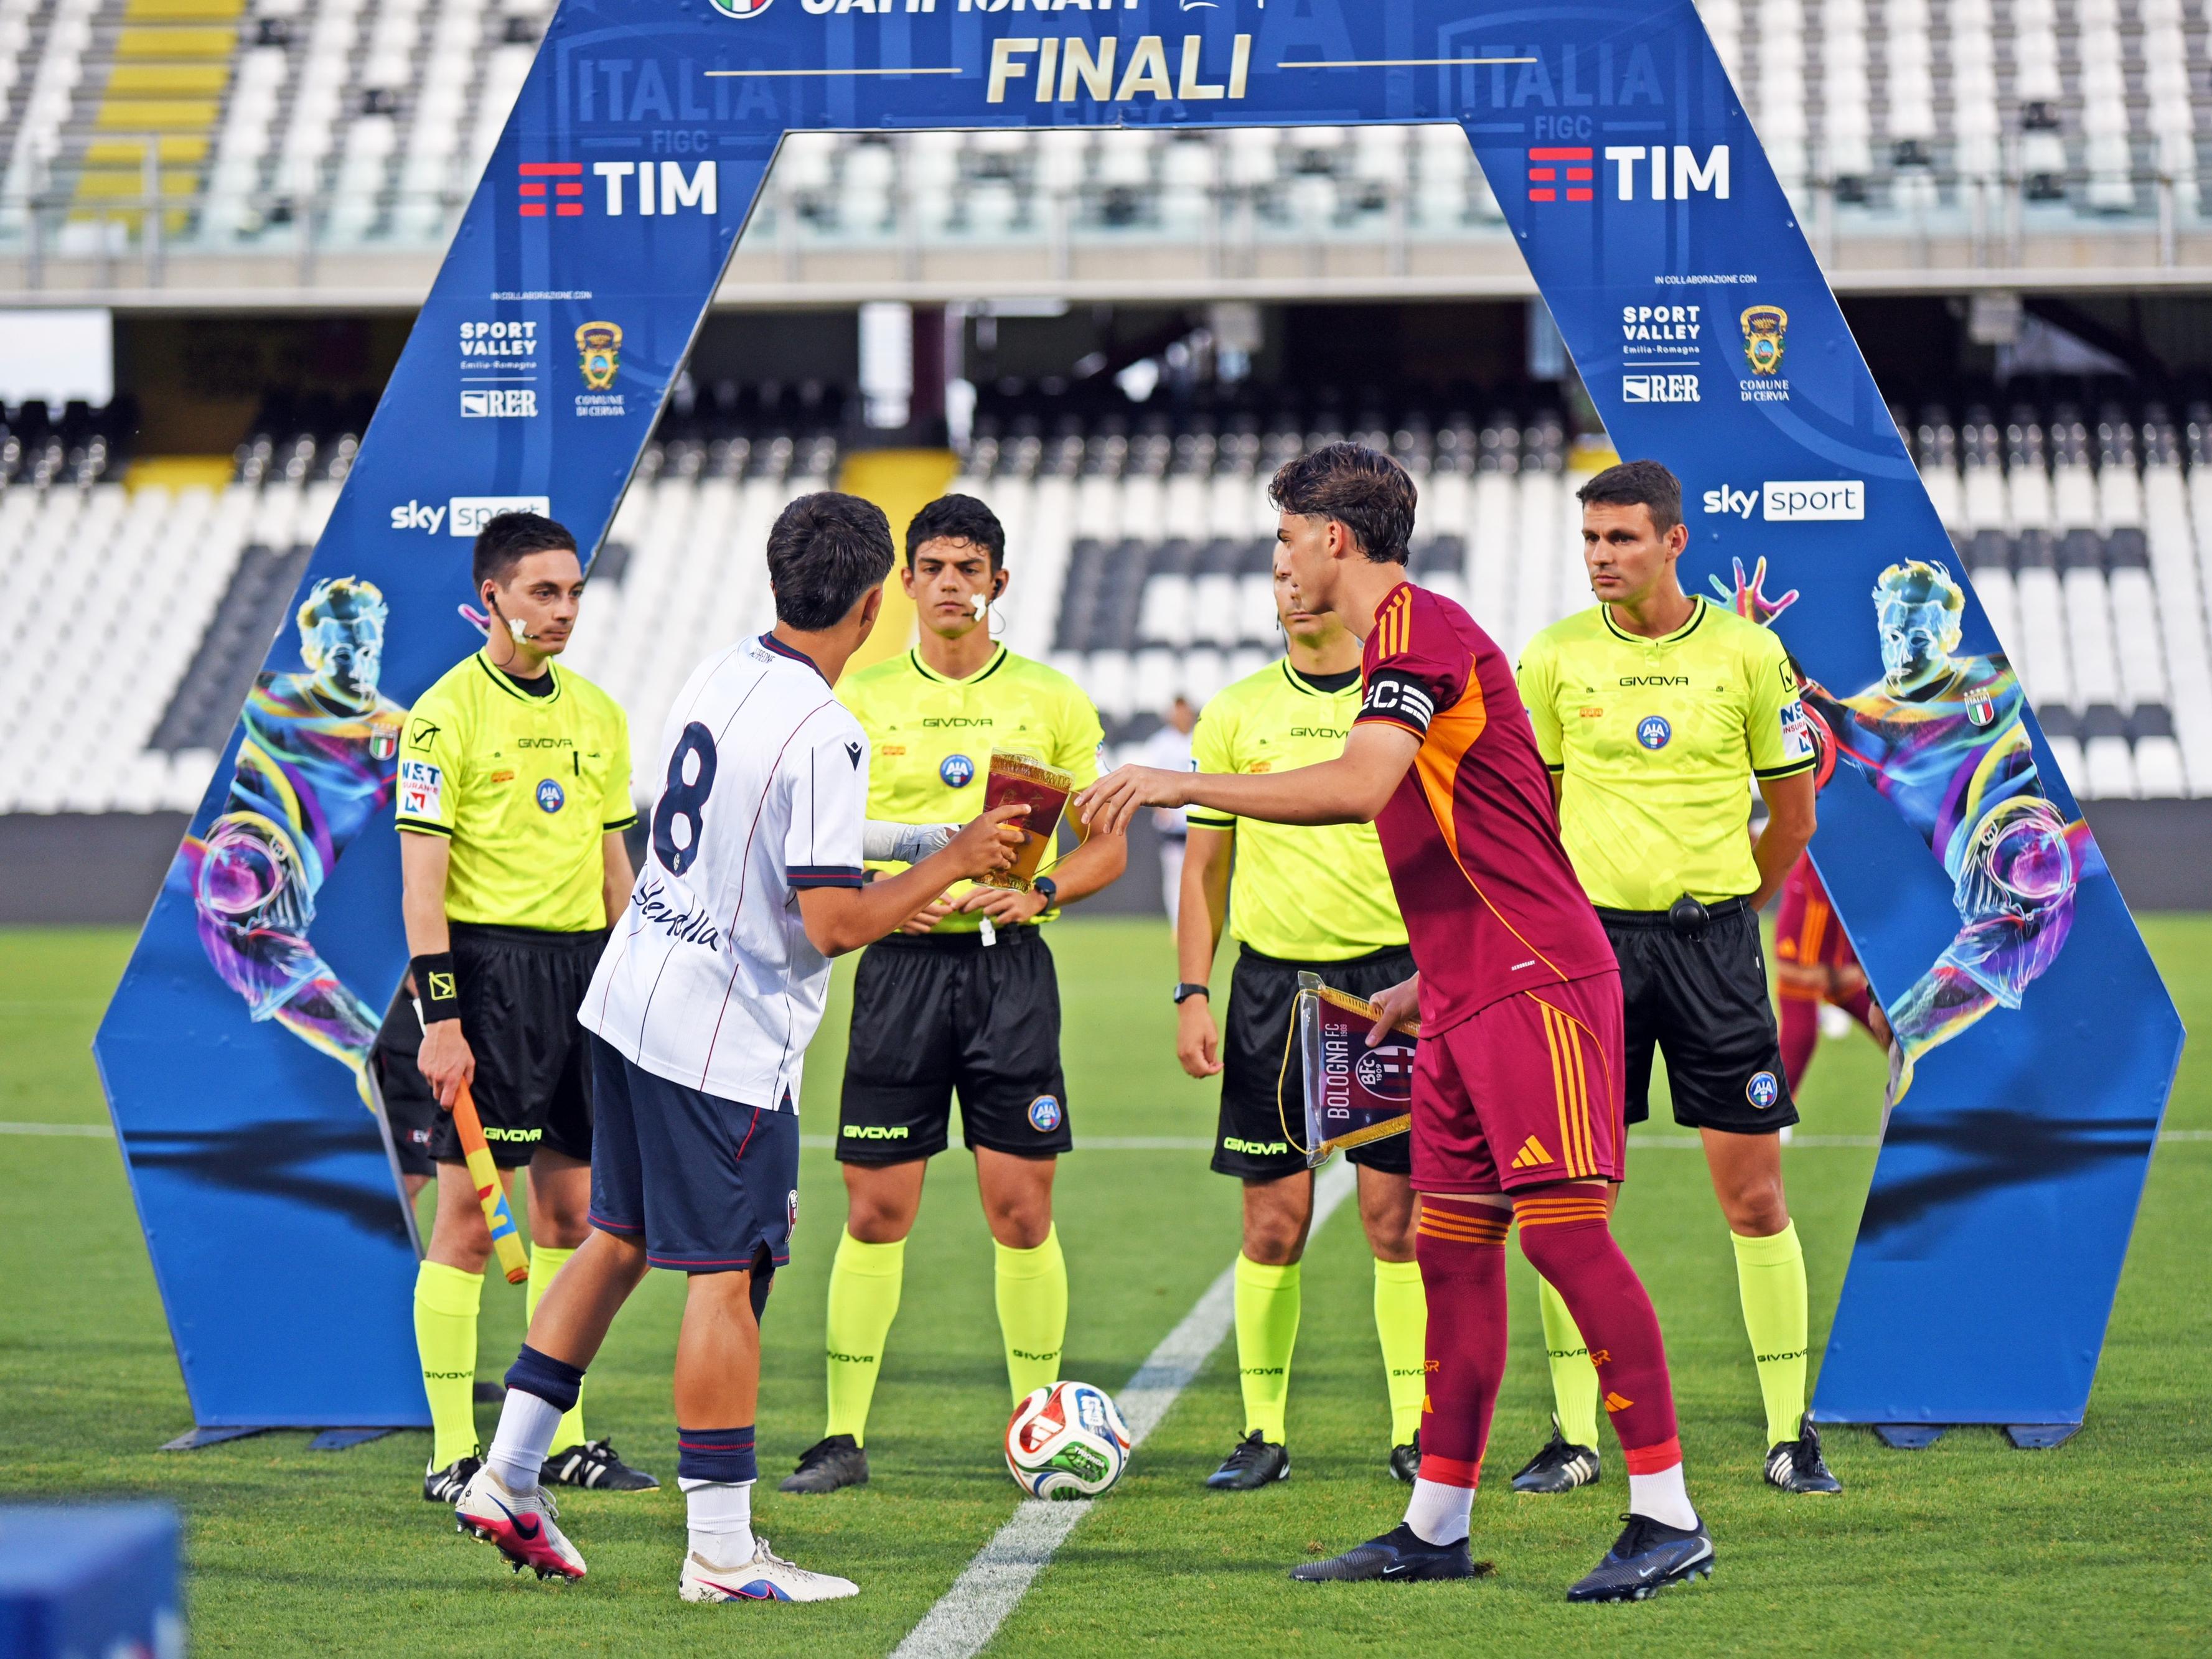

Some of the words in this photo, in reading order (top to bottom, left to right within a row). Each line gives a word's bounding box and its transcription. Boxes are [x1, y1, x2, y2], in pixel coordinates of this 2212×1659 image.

[986, 34, 1251, 103] FINALI
[1535, 115, 1593, 140] FIGC
[651, 129, 709, 153] FIGC
[1605, 145, 1730, 201] TIM
[593, 161, 717, 216] TIM
[1654, 276, 1664, 284] IN
[1665, 275, 1738, 284] COLLABORAZIONE
[1739, 274, 1757, 283] CON
[1623, 306, 1700, 323] SPORT
[460, 322, 537, 339] SPORT
[1623, 324, 1700, 340] VALLEY
[460, 340, 537, 356] VALLEY
[1623, 345, 1700, 355] Emilia-Romagna
[1740, 380, 1789, 391] COMUNE
[1741, 391, 1751, 401] DI
[1753, 391, 1790, 401] CERVIA
[1704, 484, 1760, 520] sky
[1771, 487, 1857, 516] sport
[390, 499, 447, 535] sky
[1619, 676, 1689, 687] GIVOVA
[922, 717, 993, 727] GIVOVA
[1642, 723, 1666, 737] AIA
[1290, 727, 1350, 739] GIVOV
[518, 738, 573, 749] GIVOVA
[654, 721, 718, 878] 8
[1325, 1023, 1340, 1037] FC
[1340, 1024, 1348, 1037] 1909
[1359, 1058, 1376, 1085] BFC
[1325, 1041, 1350, 1119] BOLOGNA
[482, 1126, 543, 1142] GIVOVA
[843, 1124, 909, 1139] GIVOVA
[1223, 1136, 1288, 1155] GIVOVA
